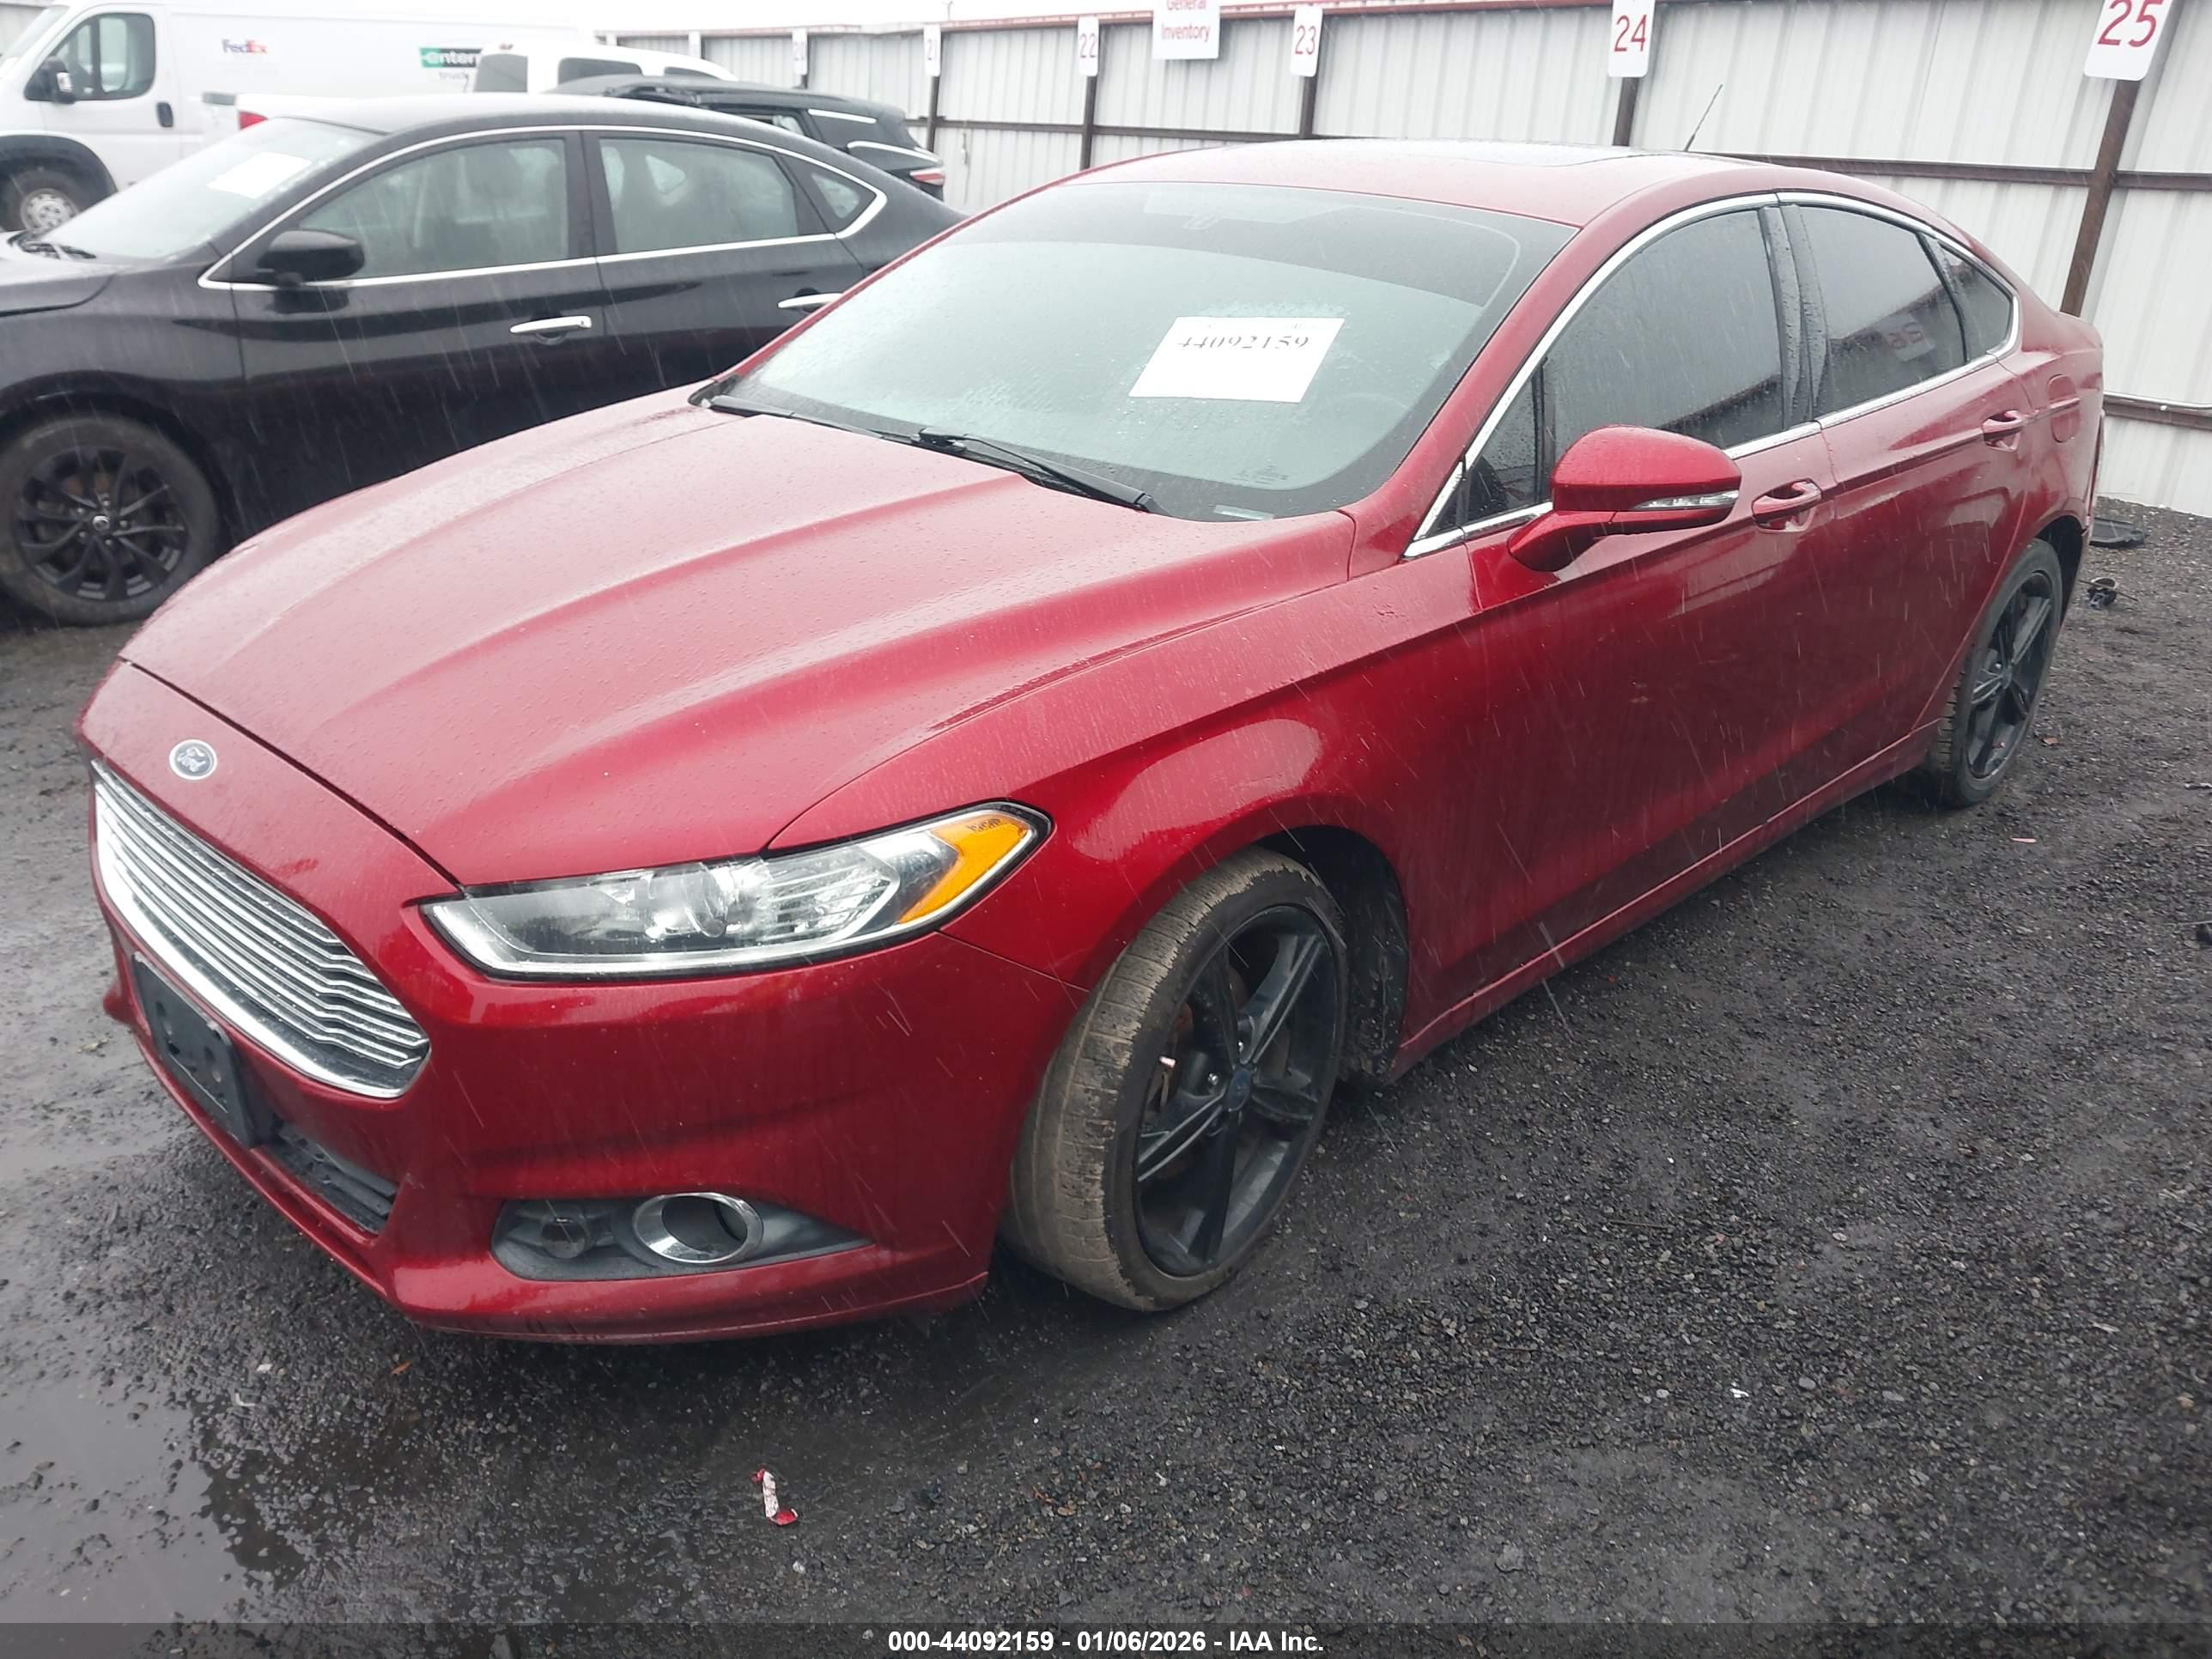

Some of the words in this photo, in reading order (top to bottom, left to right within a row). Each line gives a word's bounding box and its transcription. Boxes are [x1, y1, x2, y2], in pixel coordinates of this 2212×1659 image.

[1161, 22, 1211, 42] Inventory
[1614, 14, 1647, 52] 24
[2098, 0, 2163, 47] 25
[222, 39, 268, 54] FedEx
[1079, 33, 1097, 58] 22
[1295, 25, 1316, 55] 23
[1177, 335, 1310, 349] 44092159
